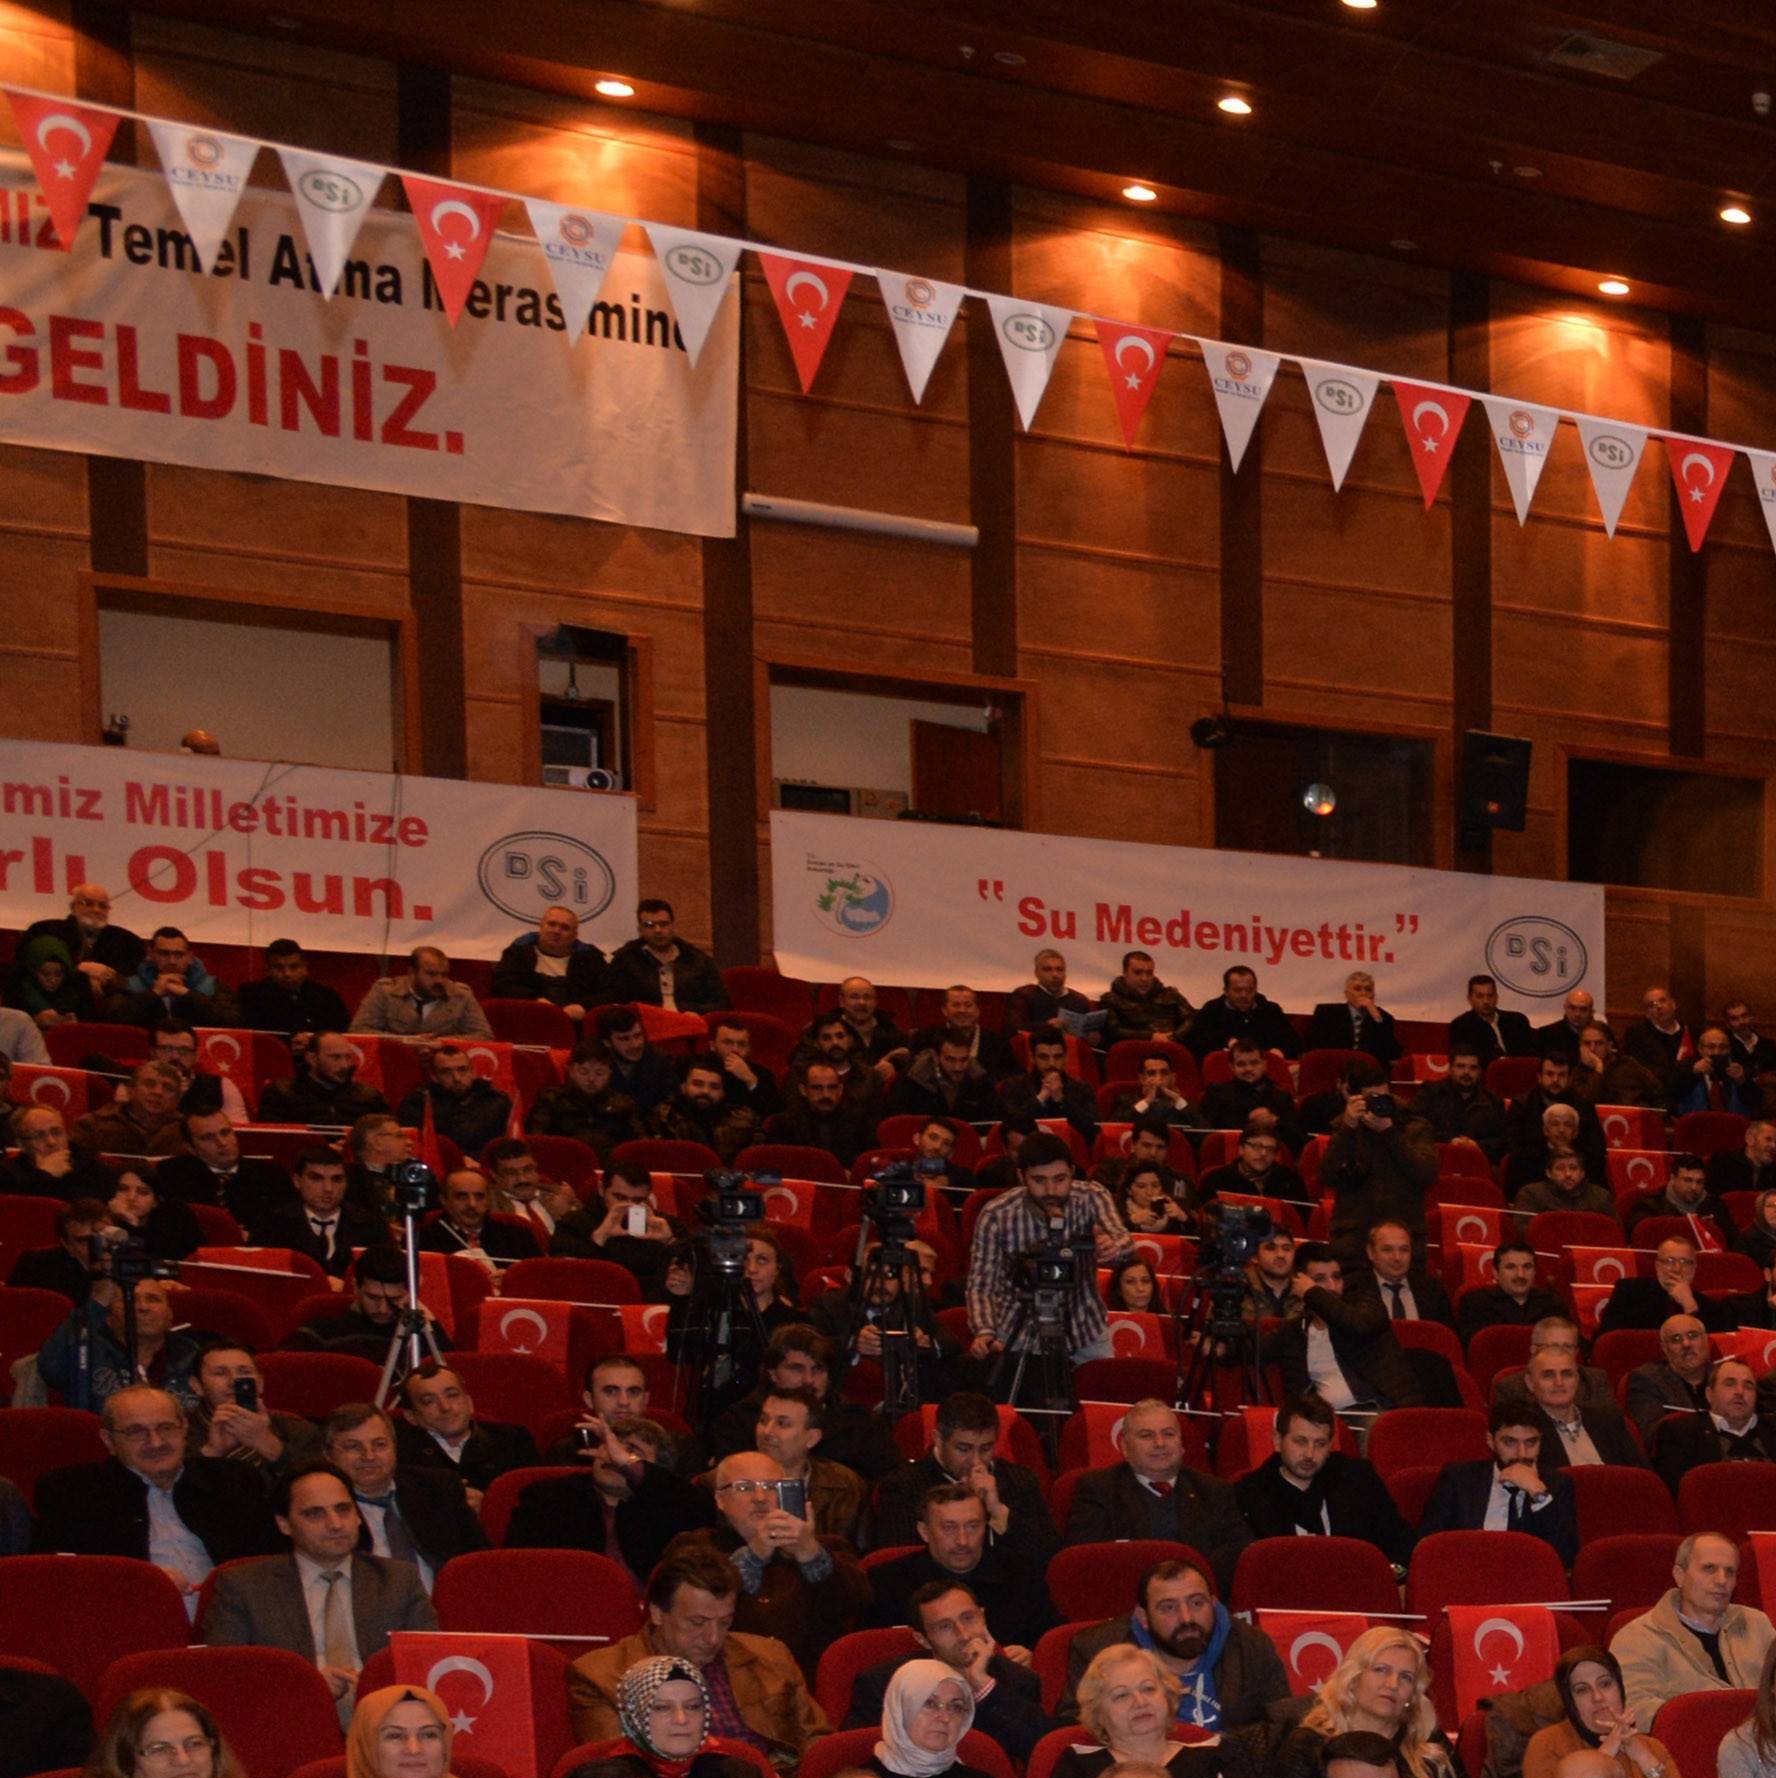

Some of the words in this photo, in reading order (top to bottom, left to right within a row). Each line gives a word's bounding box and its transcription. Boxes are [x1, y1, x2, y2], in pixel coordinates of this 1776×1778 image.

[88, 203, 250, 281] Temel
[125, 781, 429, 849] Milletimize
[127, 845, 434, 922] Olsun.
